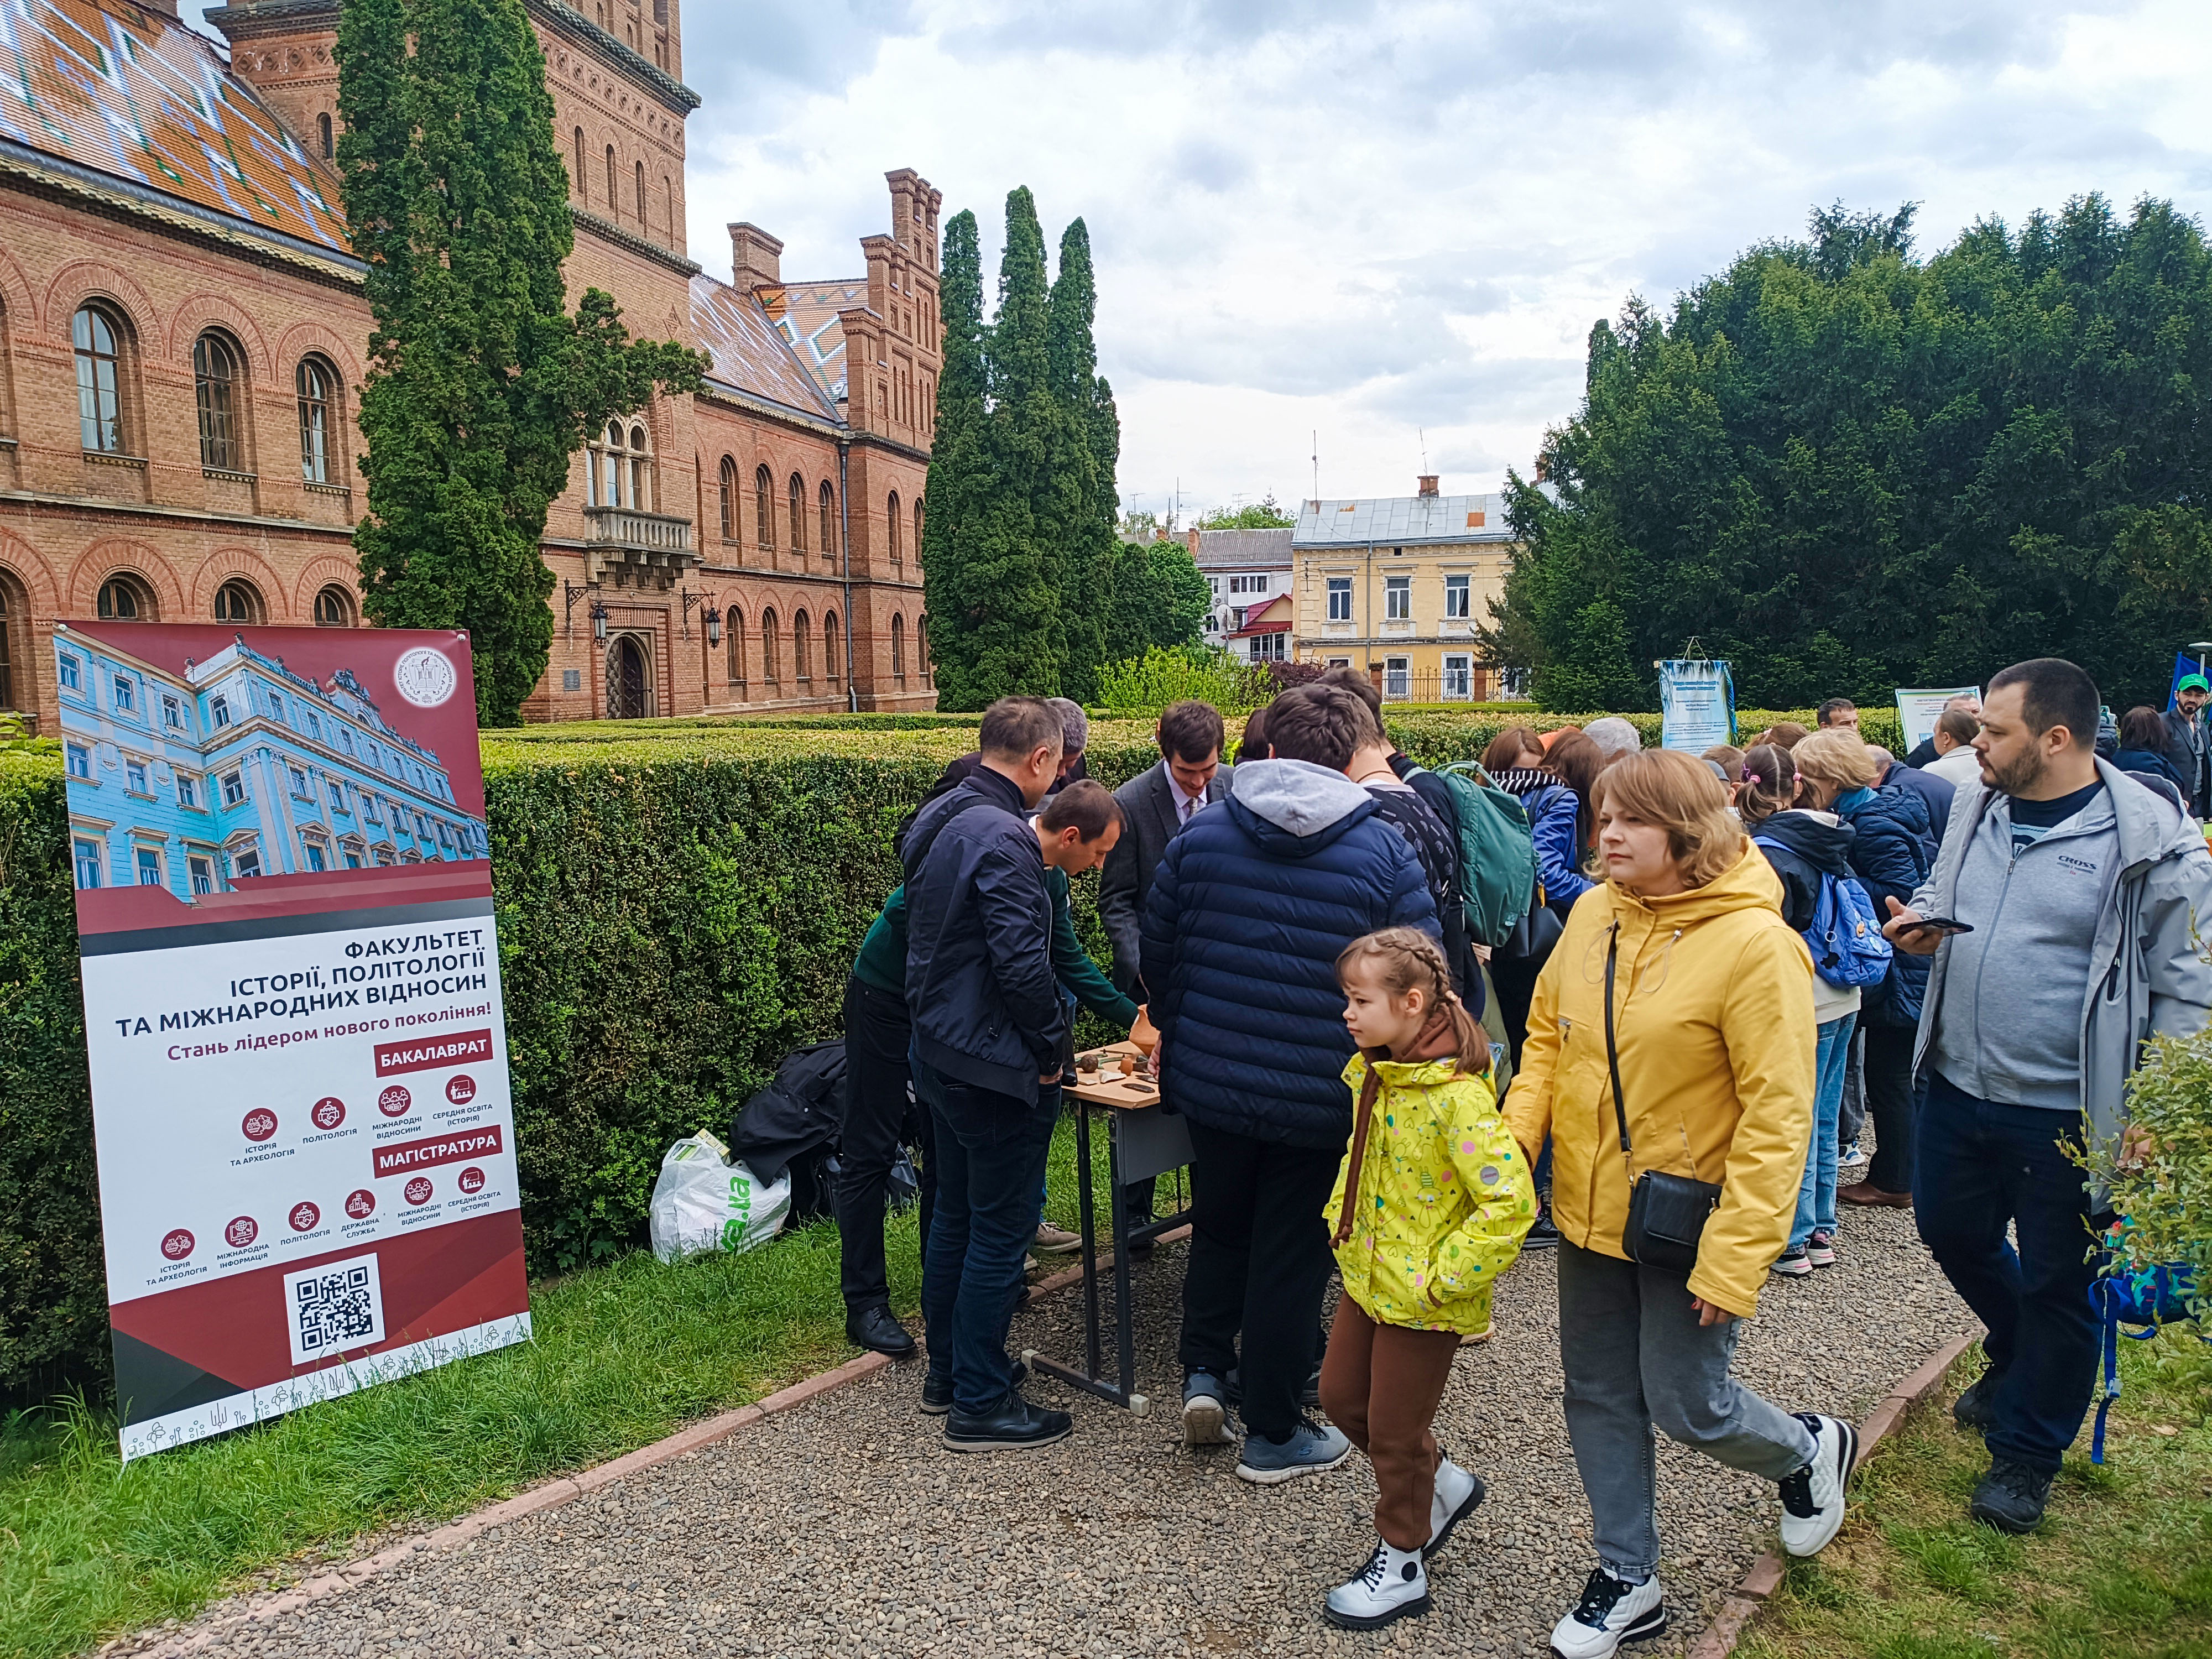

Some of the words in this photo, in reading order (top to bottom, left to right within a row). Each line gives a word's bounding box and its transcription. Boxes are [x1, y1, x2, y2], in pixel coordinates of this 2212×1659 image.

[2058, 855, 2097, 870] CROSS
[345, 929, 483, 959] ФАКУЛЬТЕТ
[231, 967, 326, 997] ІСТОРІЇ,
[332, 947, 485, 984] ПОЛІТОЛОГІЇ
[116, 1016, 152, 1037] ТА
[160, 990, 359, 1032] МІЖНАРОДНИХ
[367, 973, 487, 1005] ВІДНОСИН
[168, 1041, 229, 1061] Стань
[234, 1029, 318, 1051] лідером
[324, 1018, 389, 1037] нового
[395, 1001, 492, 1029] покоління!
[380, 1039, 487, 1068] БАКАЛАВРАТ
[432, 1109, 466, 1120] СЕРЕДНЯ
[467, 1104, 493, 1115] ОСВІТА
[372, 1116, 422, 1131] МІЖНАРОДНІ
[447, 1115, 480, 1127] (ІСТОРІЯ)
[302, 1129, 357, 1144] ПОЛІТОЛОГІЯ
[377, 1125, 421, 1139] ВІДНОСИНИ
[245, 1142, 276, 1154] ІСТОРІЯ
[379, 1135, 497, 1168] МАГІСТРАТУРА
[243, 1149, 295, 1165] АРХЕОЛОГІЯ
[448, 1196, 477, 1208] СЕРЕДНЯ
[478, 1191, 501, 1201] ОСВІТА
[461, 1201, 489, 1213] (ІСТОРІЯ)
[398, 1203, 441, 1218] МІЖНАРОДНІ
[401, 1212, 441, 1225] ВІДНОСИНИ
[341, 1218, 379, 1232] ДЕРЖАВНА
[347, 1227, 375, 1239] СЛУЖБА
[280, 1229, 330, 1245] ПОЛІТОЛОГІЯ
[217, 1244, 269, 1260] МІЖНАРОДНА
[160, 1261, 190, 1273] ІСТОРІЯ
[220, 1253, 268, 1269] ІНФОРМАЦІЯ
[158, 1266, 207, 1284] АРХЕОЛОГІЯ
